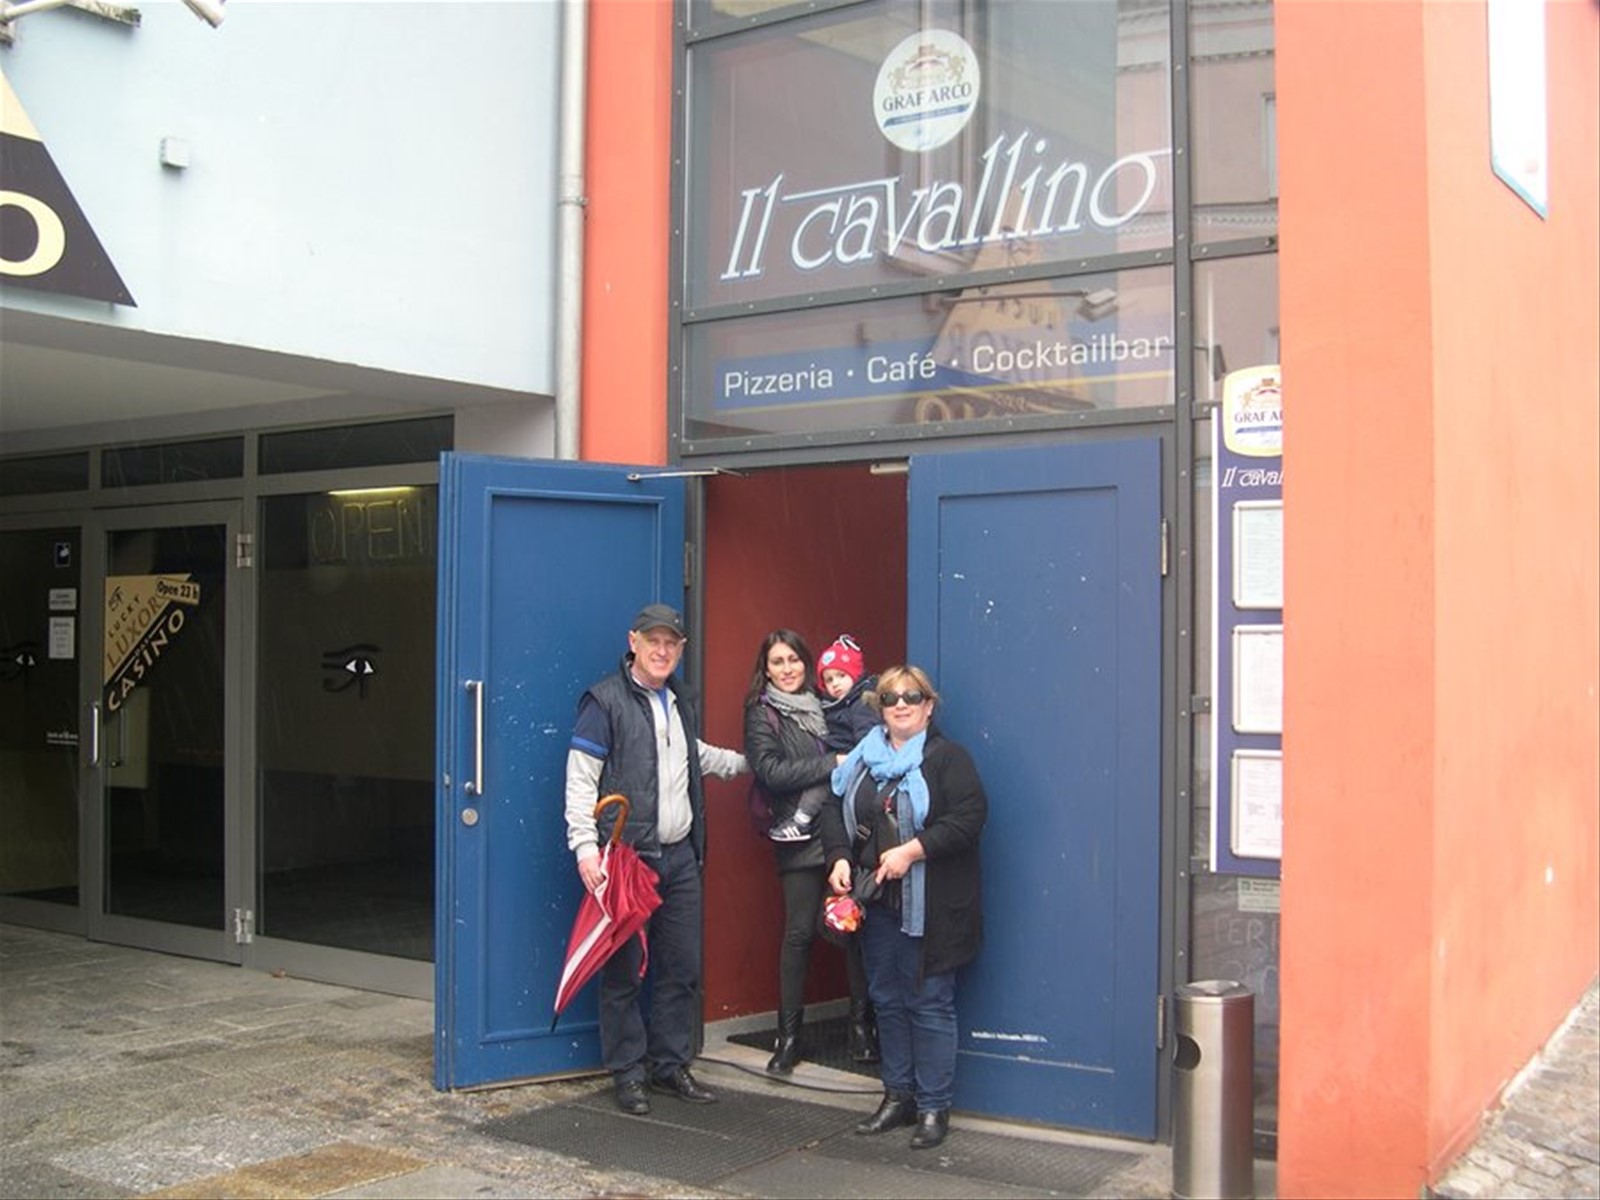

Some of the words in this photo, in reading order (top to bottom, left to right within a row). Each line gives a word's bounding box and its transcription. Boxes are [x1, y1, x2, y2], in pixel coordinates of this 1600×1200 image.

[882, 91, 924, 112] GRAF
[928, 82, 972, 103] ARCO
[720, 173, 784, 280] Il
[781, 129, 1171, 269] cavallino
[724, 363, 833, 397] Pizzeria
[867, 352, 936, 384] Café
[973, 333, 1170, 374] Cocktailbar
[1234, 410, 1265, 424] GRAF
[1221, 466, 1237, 488] Il
[311, 499, 424, 562] OPEN
[107, 596, 163, 669] LUXOR
[108, 596, 140, 638] LUCKY
[108, 608, 185, 711] CASINO
